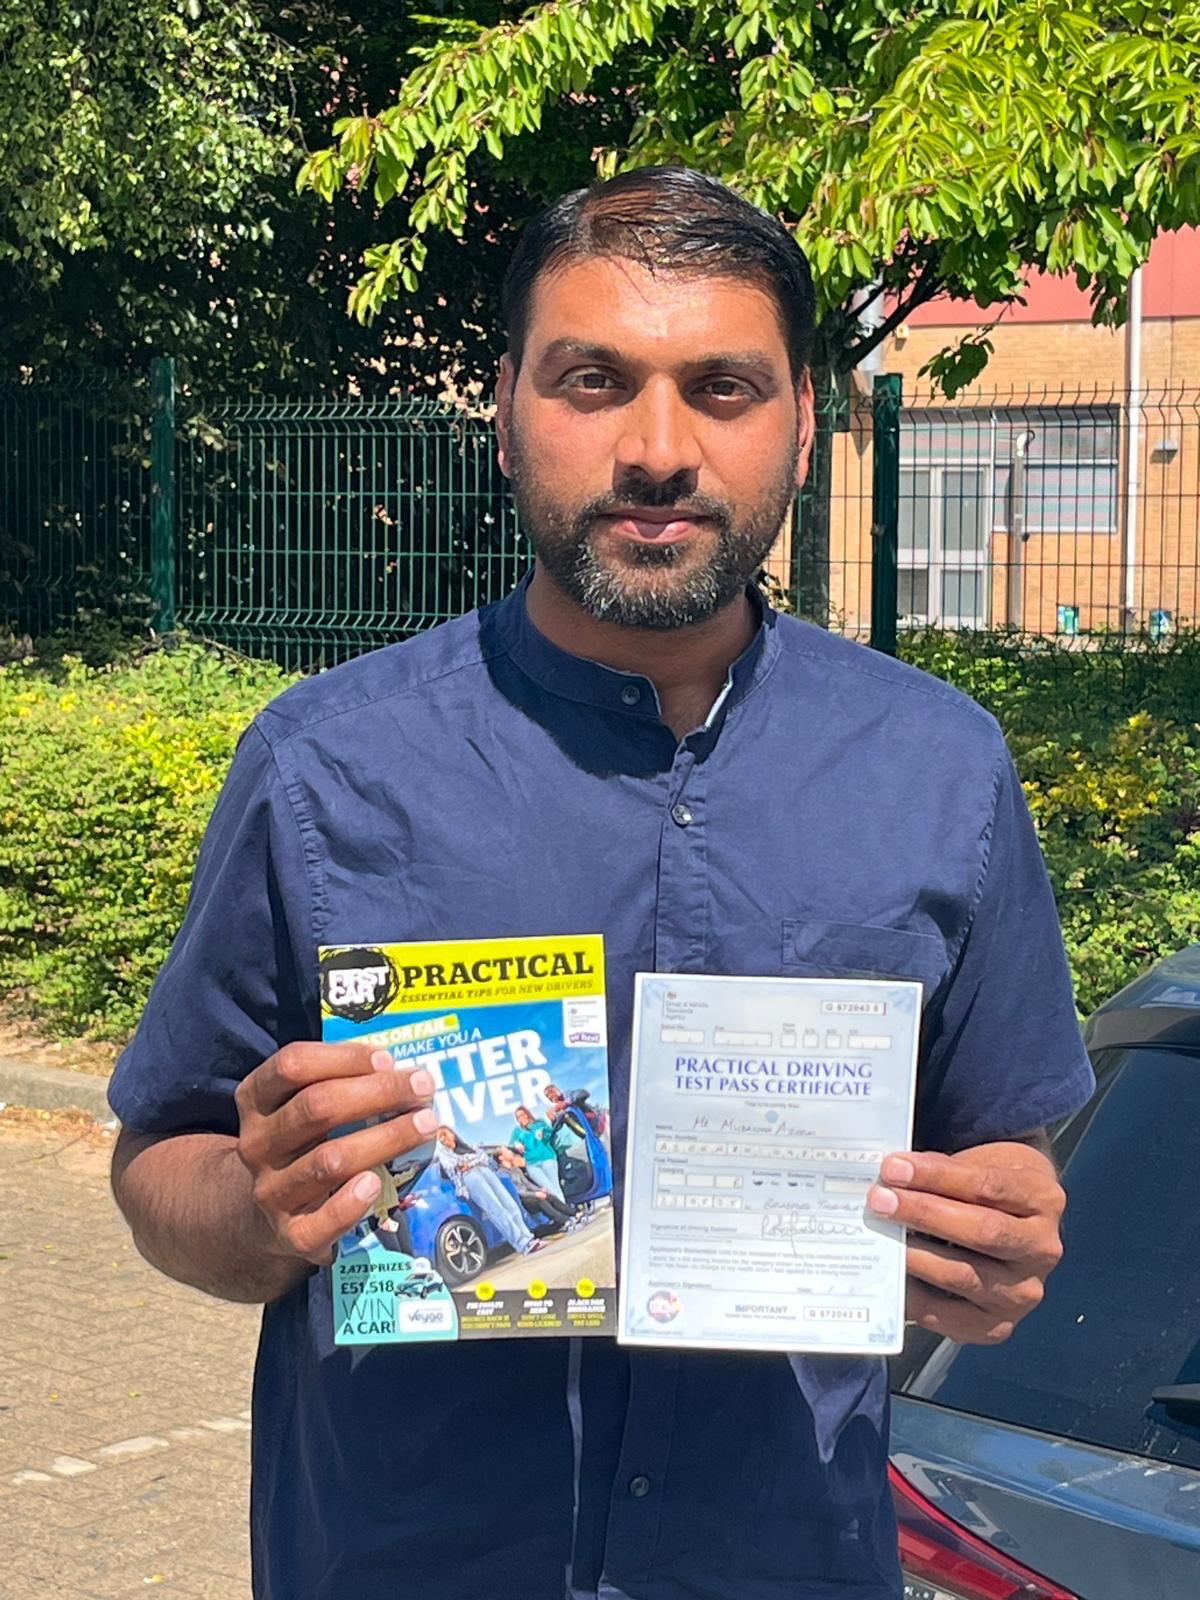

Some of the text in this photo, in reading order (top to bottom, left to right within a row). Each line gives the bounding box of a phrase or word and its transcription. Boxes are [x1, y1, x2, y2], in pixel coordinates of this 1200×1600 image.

[328, 965, 390, 988] FIRST
[402, 951, 594, 988] PRACTICAL
[328, 986, 376, 1006] CAR
[401, 979, 593, 1004] ESSENTIAL TIPS FOR NEW DRIVERS
[390, 1025, 414, 1041] OR
[394, 1027, 482, 1058] MAKE YOU A
[675, 1057, 872, 1078] PRACTICAL DRIVING
[675, 1075, 871, 1096] TEST PASS CERTIFICATE
[433, 1068, 553, 1127] IVER
[370, 1261, 411, 1272] PRIZES
[341, 1280, 395, 1295] £51,518
[342, 1298, 394, 1320] WIN
[735, 1305, 788, 1314] IMPORTANT
[343, 1320, 396, 1335] A CAR!
